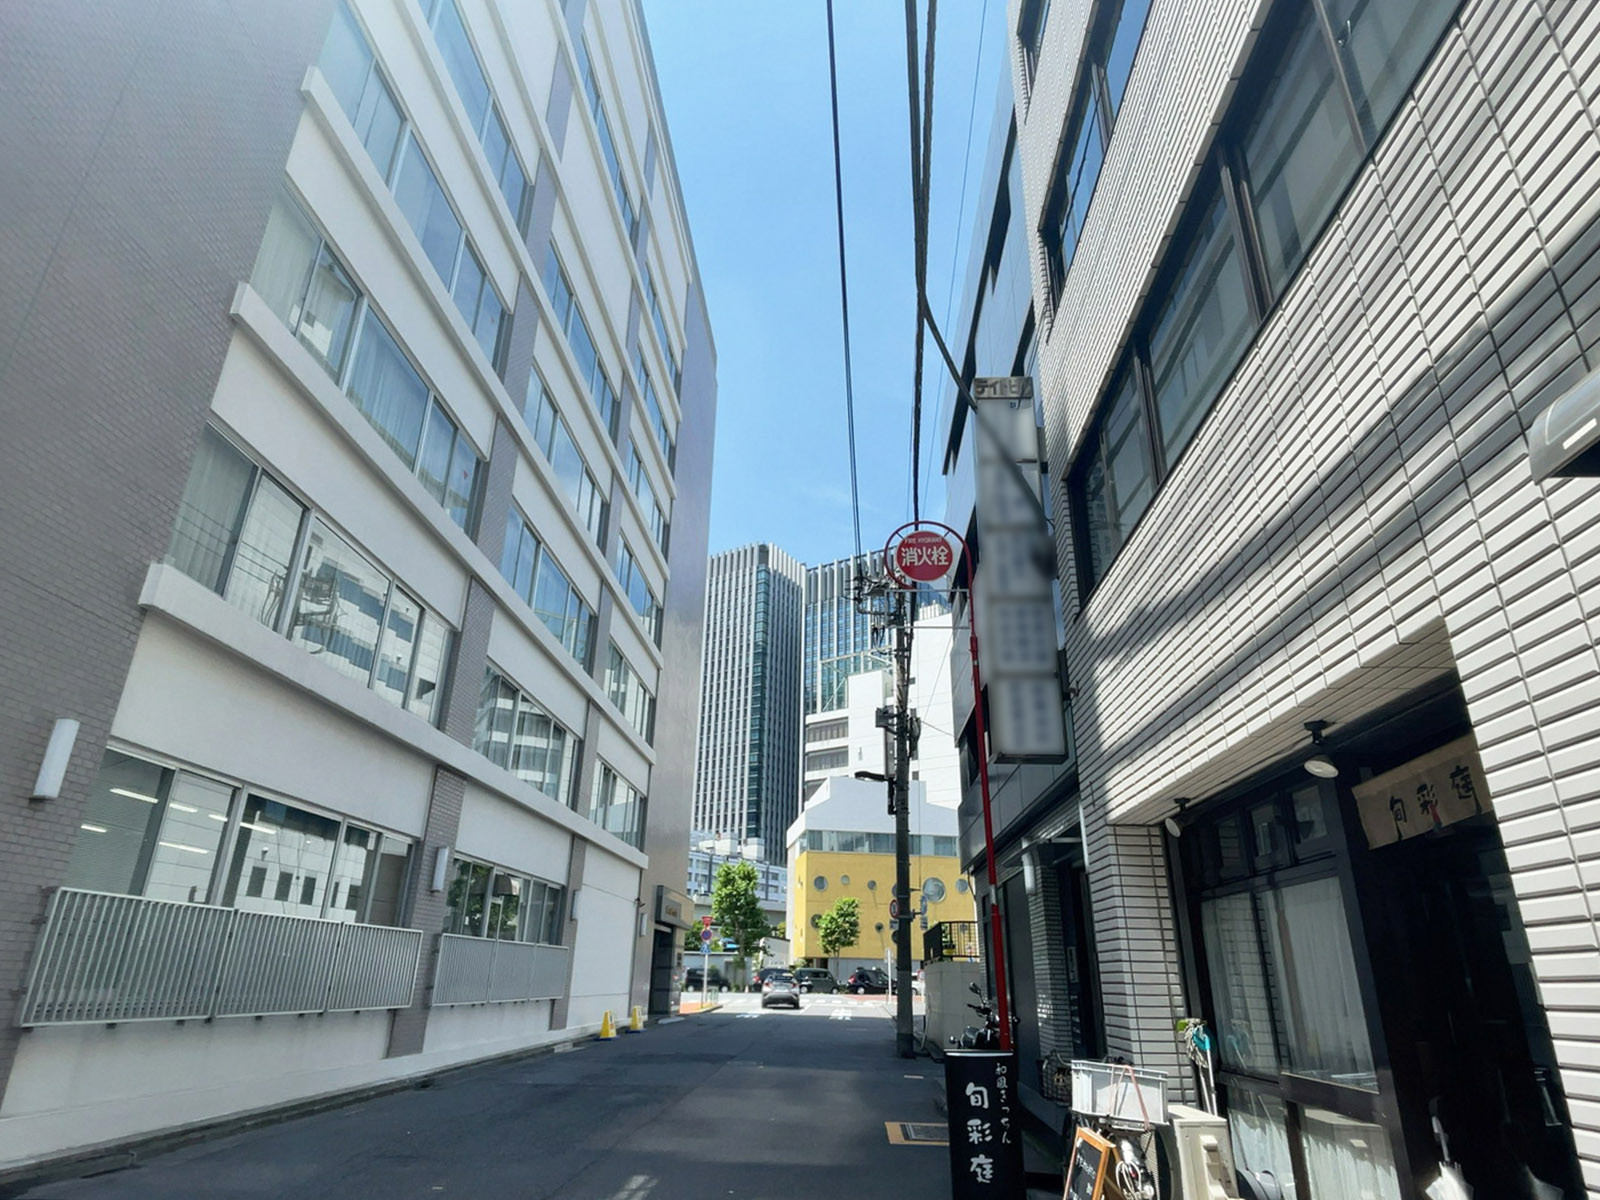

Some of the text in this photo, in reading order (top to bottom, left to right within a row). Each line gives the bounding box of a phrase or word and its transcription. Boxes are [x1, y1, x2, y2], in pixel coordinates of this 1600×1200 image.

[901, 545, 949, 567] 消火栓
[1389, 765, 1475, 823] 旬彩庭
[965, 1082, 994, 1184] 旬彩庭
